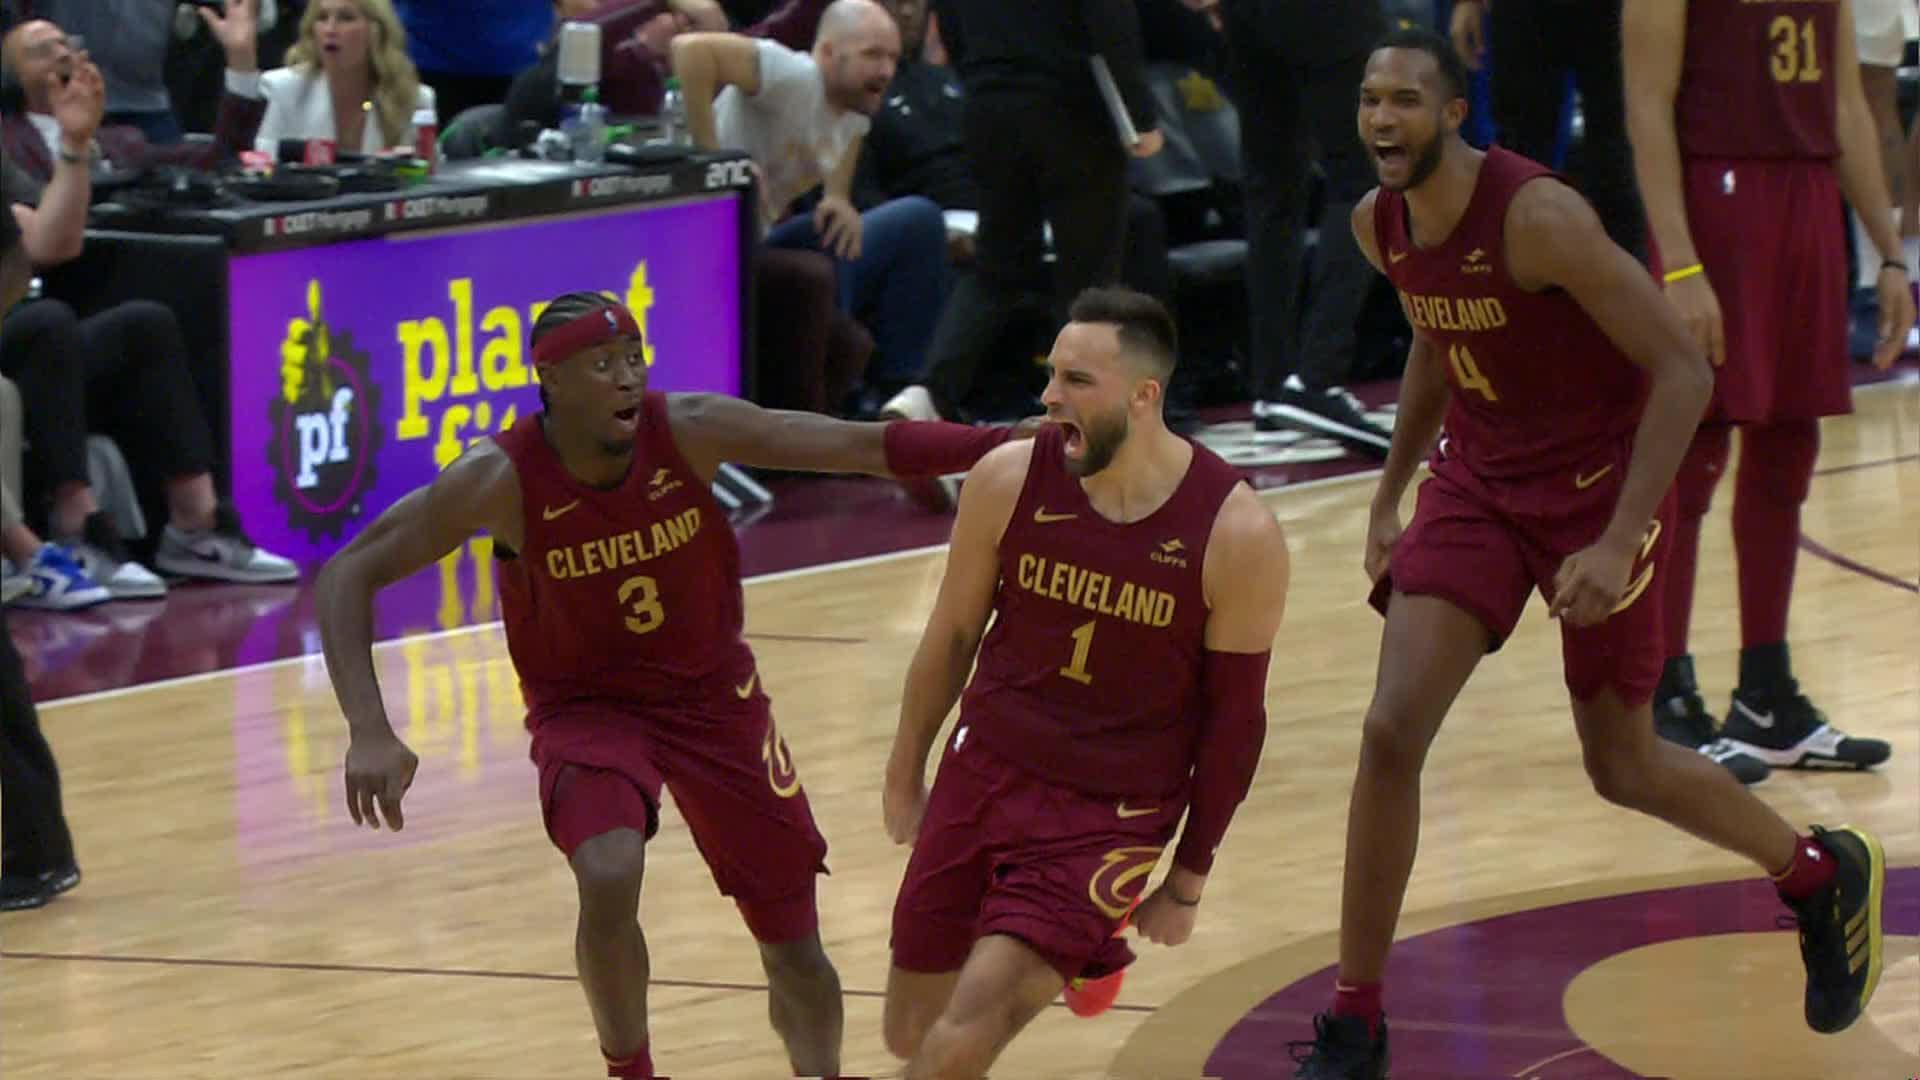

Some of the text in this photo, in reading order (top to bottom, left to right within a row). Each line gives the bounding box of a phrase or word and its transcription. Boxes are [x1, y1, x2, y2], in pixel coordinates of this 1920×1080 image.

[1768, 15, 1823, 82] 31
[397, 258, 655, 440] plat
[1449, 343, 1498, 401] 4
[295, 386, 354, 488] pf
[546, 507, 701, 580] CLEVELAND
[617, 575, 665, 635] 3
[1018, 553, 1176, 628] CLEVELAND
[1059, 620, 1097, 685] 1
